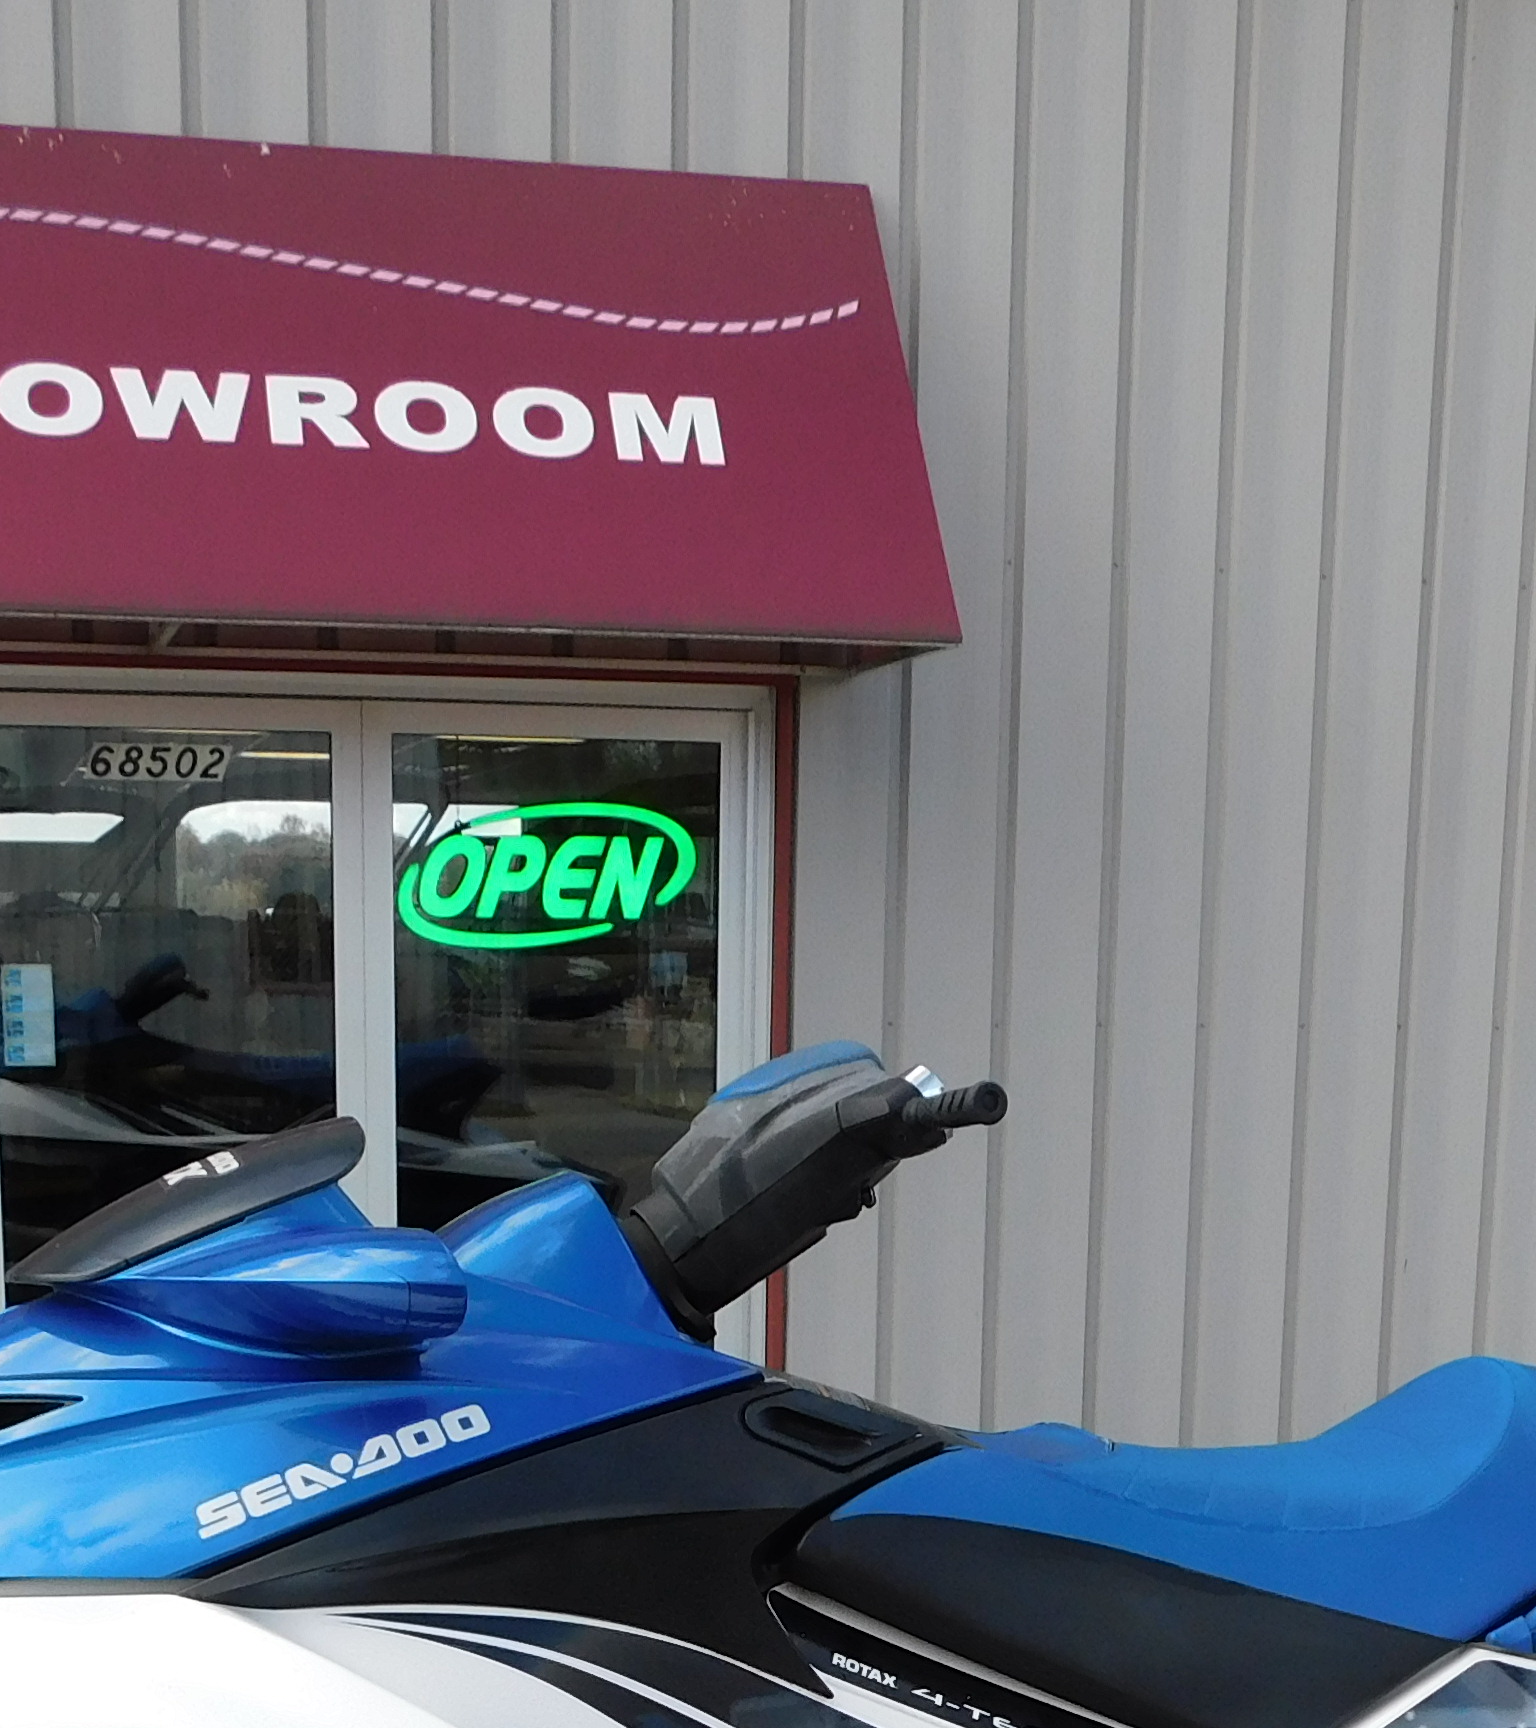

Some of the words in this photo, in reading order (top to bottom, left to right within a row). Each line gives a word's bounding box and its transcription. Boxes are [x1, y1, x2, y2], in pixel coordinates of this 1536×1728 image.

[90, 745, 225, 779] 68502
[419, 833, 664, 920] OPEN
[831, 1652, 897, 1688] ROTAX
